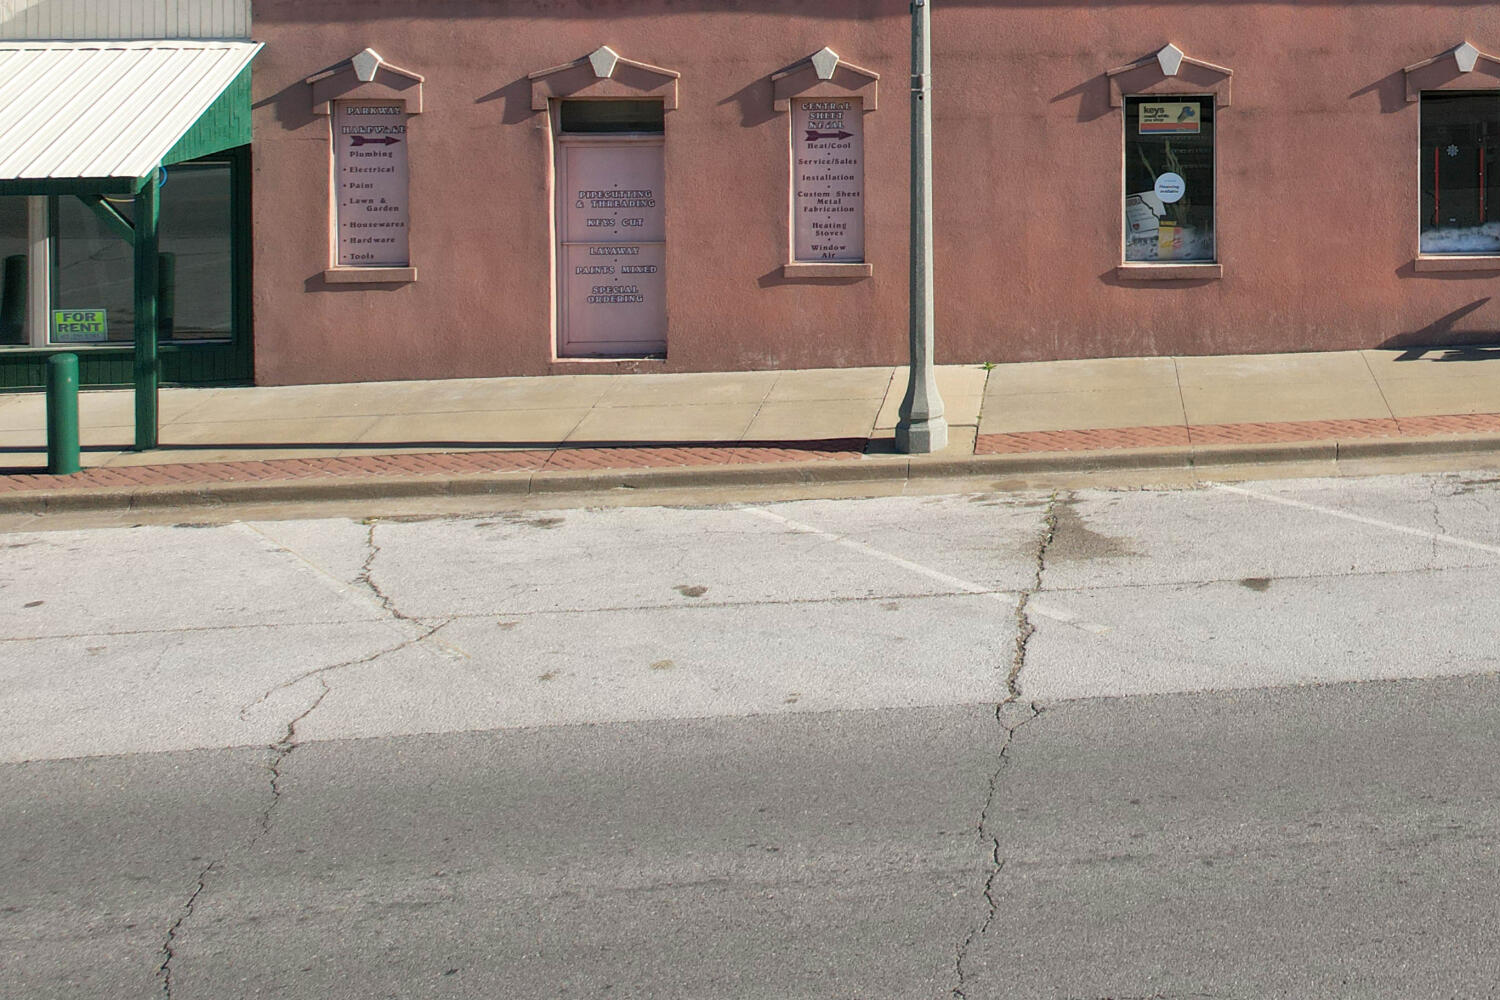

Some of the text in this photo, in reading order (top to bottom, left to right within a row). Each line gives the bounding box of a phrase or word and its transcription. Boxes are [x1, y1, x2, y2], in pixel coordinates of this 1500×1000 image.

[347, 106, 401, 115] PARKWAY
[801, 102, 851, 111] CENTRAL
[1143, 105, 1165, 116] keys
[808, 112, 843, 120] SHEET
[808, 121, 844, 129] METAL
[349, 165, 395, 173] Electrical
[578, 190, 653, 199] PIPECUTTING
[591, 199, 656, 208] THREADING
[586, 218, 644, 227] KEYS CUT
[812, 222, 847, 230] Heating
[589, 247, 640, 255] LAYAWAY
[350, 252, 374, 260] Tools
[576, 265, 657, 275] PAINTS MIXED
[592, 285, 639, 294] SPECIAL
[587, 295, 644, 304] ORDERING
[63, 312, 96, 322] FOR
[58, 323, 102, 332] RENT
